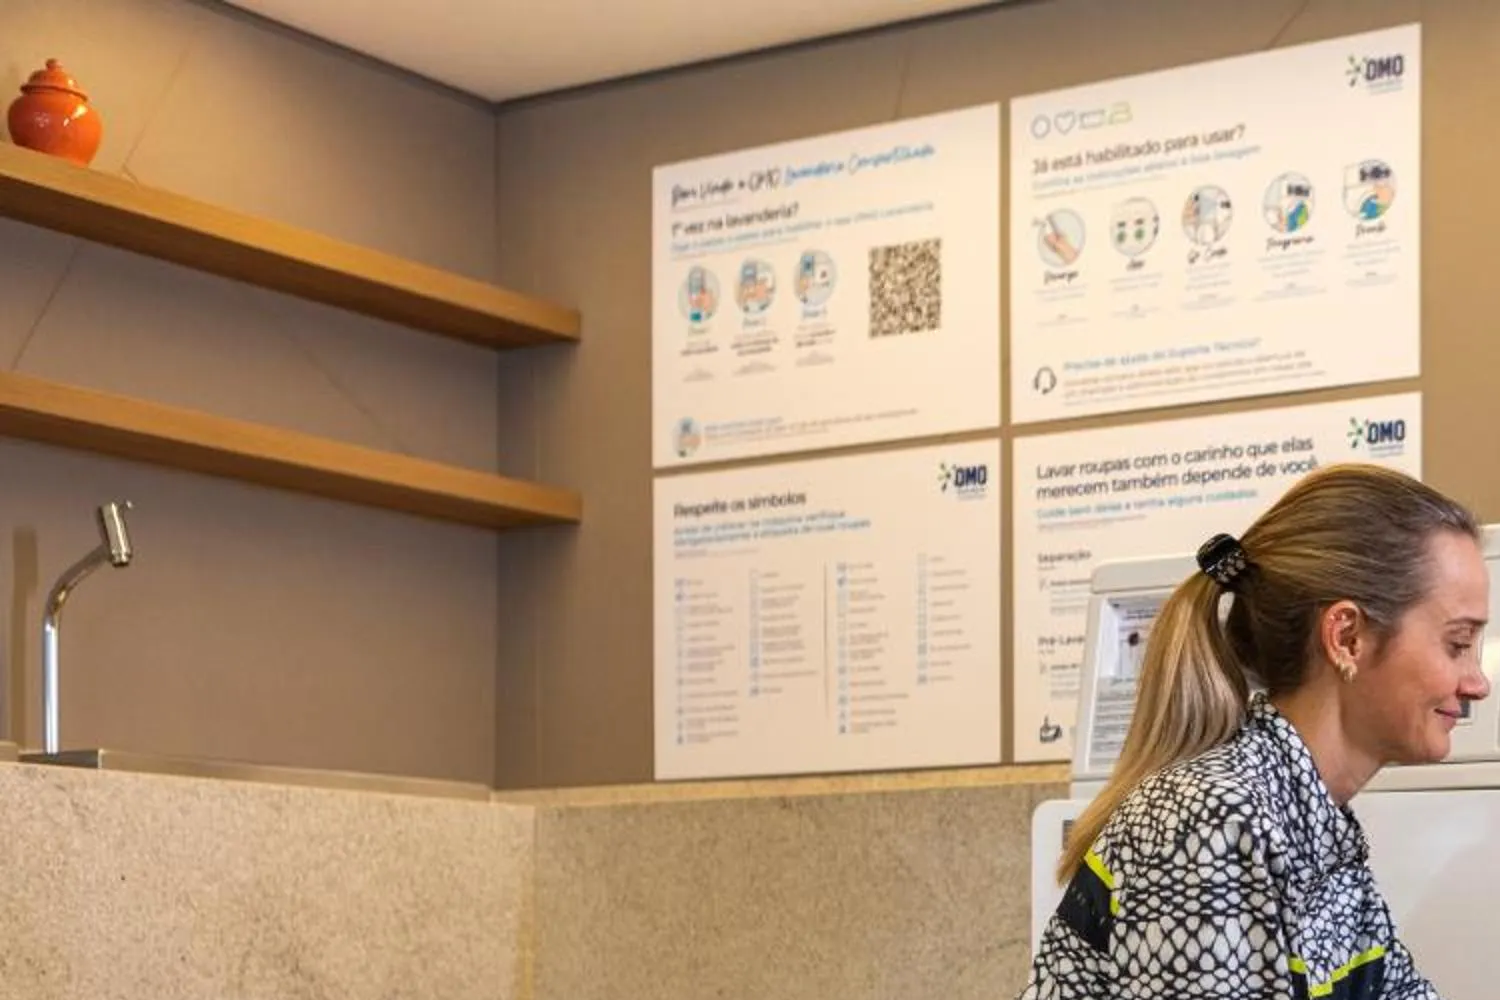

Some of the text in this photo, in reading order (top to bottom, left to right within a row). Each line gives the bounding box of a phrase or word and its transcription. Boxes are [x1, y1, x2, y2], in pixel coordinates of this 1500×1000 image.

[1365, 54, 1403, 81] OMO
[1052, 154, 1082, 172] está
[1086, 139, 1161, 166] habilitado
[1164, 134, 1199, 156] para
[1202, 124, 1246, 145] usar?
[1367, 418, 1405, 444] OMO
[1037, 462, 1077, 479] Lavar
[1079, 458, 1130, 478] roupas
[1133, 453, 1168, 469] com
[1184, 445, 1244, 463] carinho
[1247, 442, 1278, 461] que
[1282, 436, 1313, 452] elas
[955, 465, 987, 487] OMO
[1037, 480, 1108, 499] merecem
[1112, 470, 1179, 490] também
[1182, 463, 1252, 486] depende
[1255, 460, 1276, 477] de
